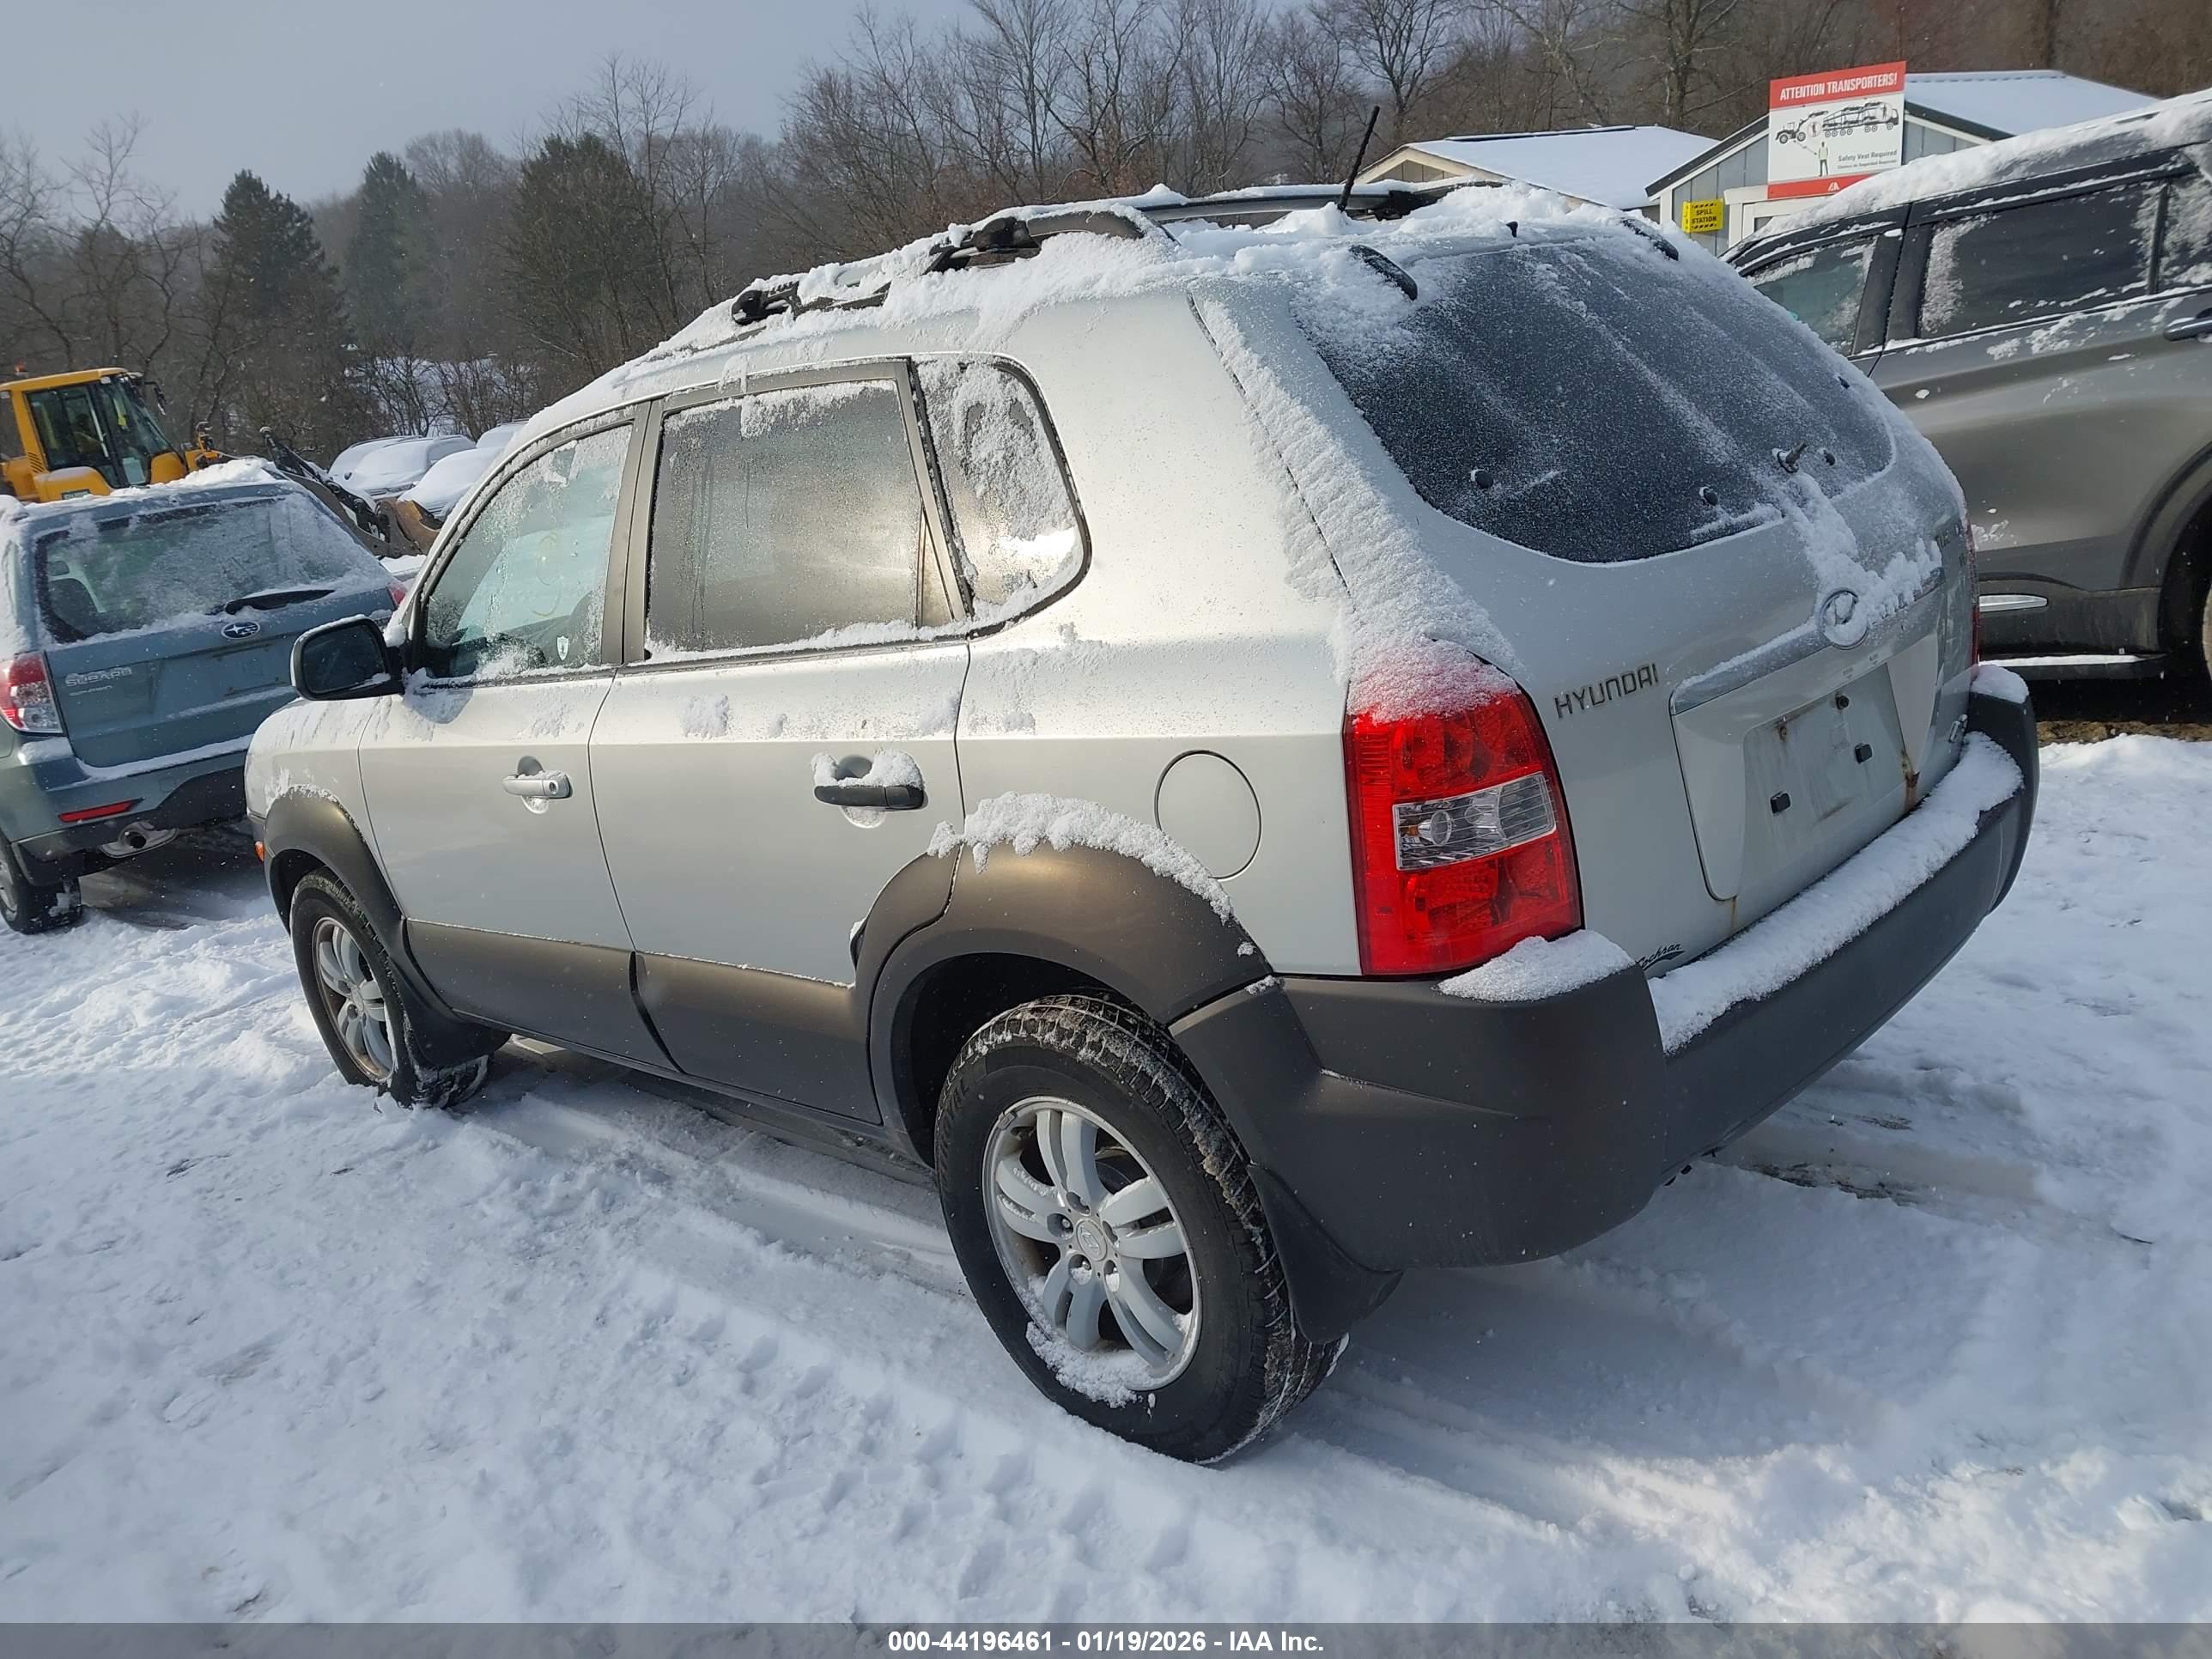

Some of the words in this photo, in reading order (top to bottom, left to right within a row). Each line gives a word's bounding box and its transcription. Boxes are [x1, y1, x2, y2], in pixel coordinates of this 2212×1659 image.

[1780, 82, 1825, 100] ATTENTION
[1827, 72, 1898, 94] TRANSPORTERS!
[1692, 216, 1717, 224] STATION
[1554, 663, 1659, 719] HYUNDAI
